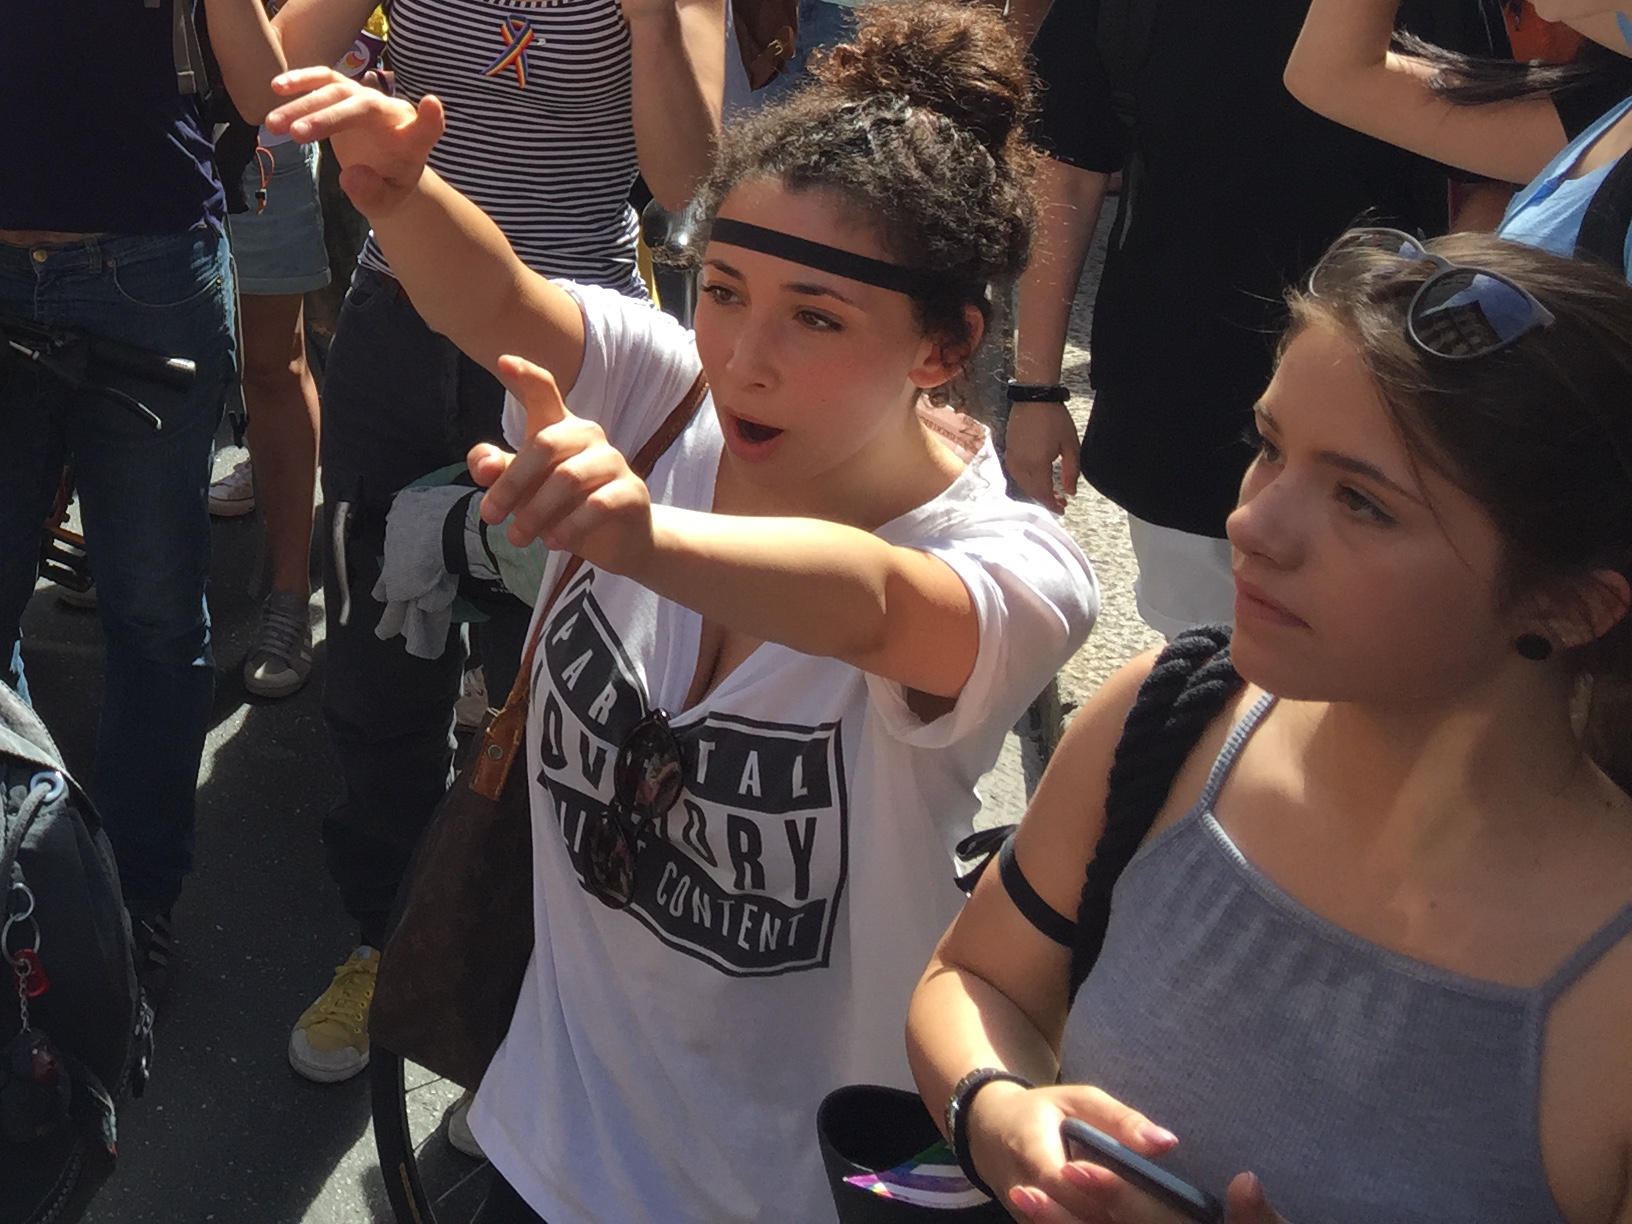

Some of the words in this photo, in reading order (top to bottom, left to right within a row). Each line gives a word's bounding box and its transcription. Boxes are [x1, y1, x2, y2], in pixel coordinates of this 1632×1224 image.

[541, 690, 817, 901] DVORY
[552, 612, 807, 797] PARTAL
[656, 860, 805, 954] CONTENT
